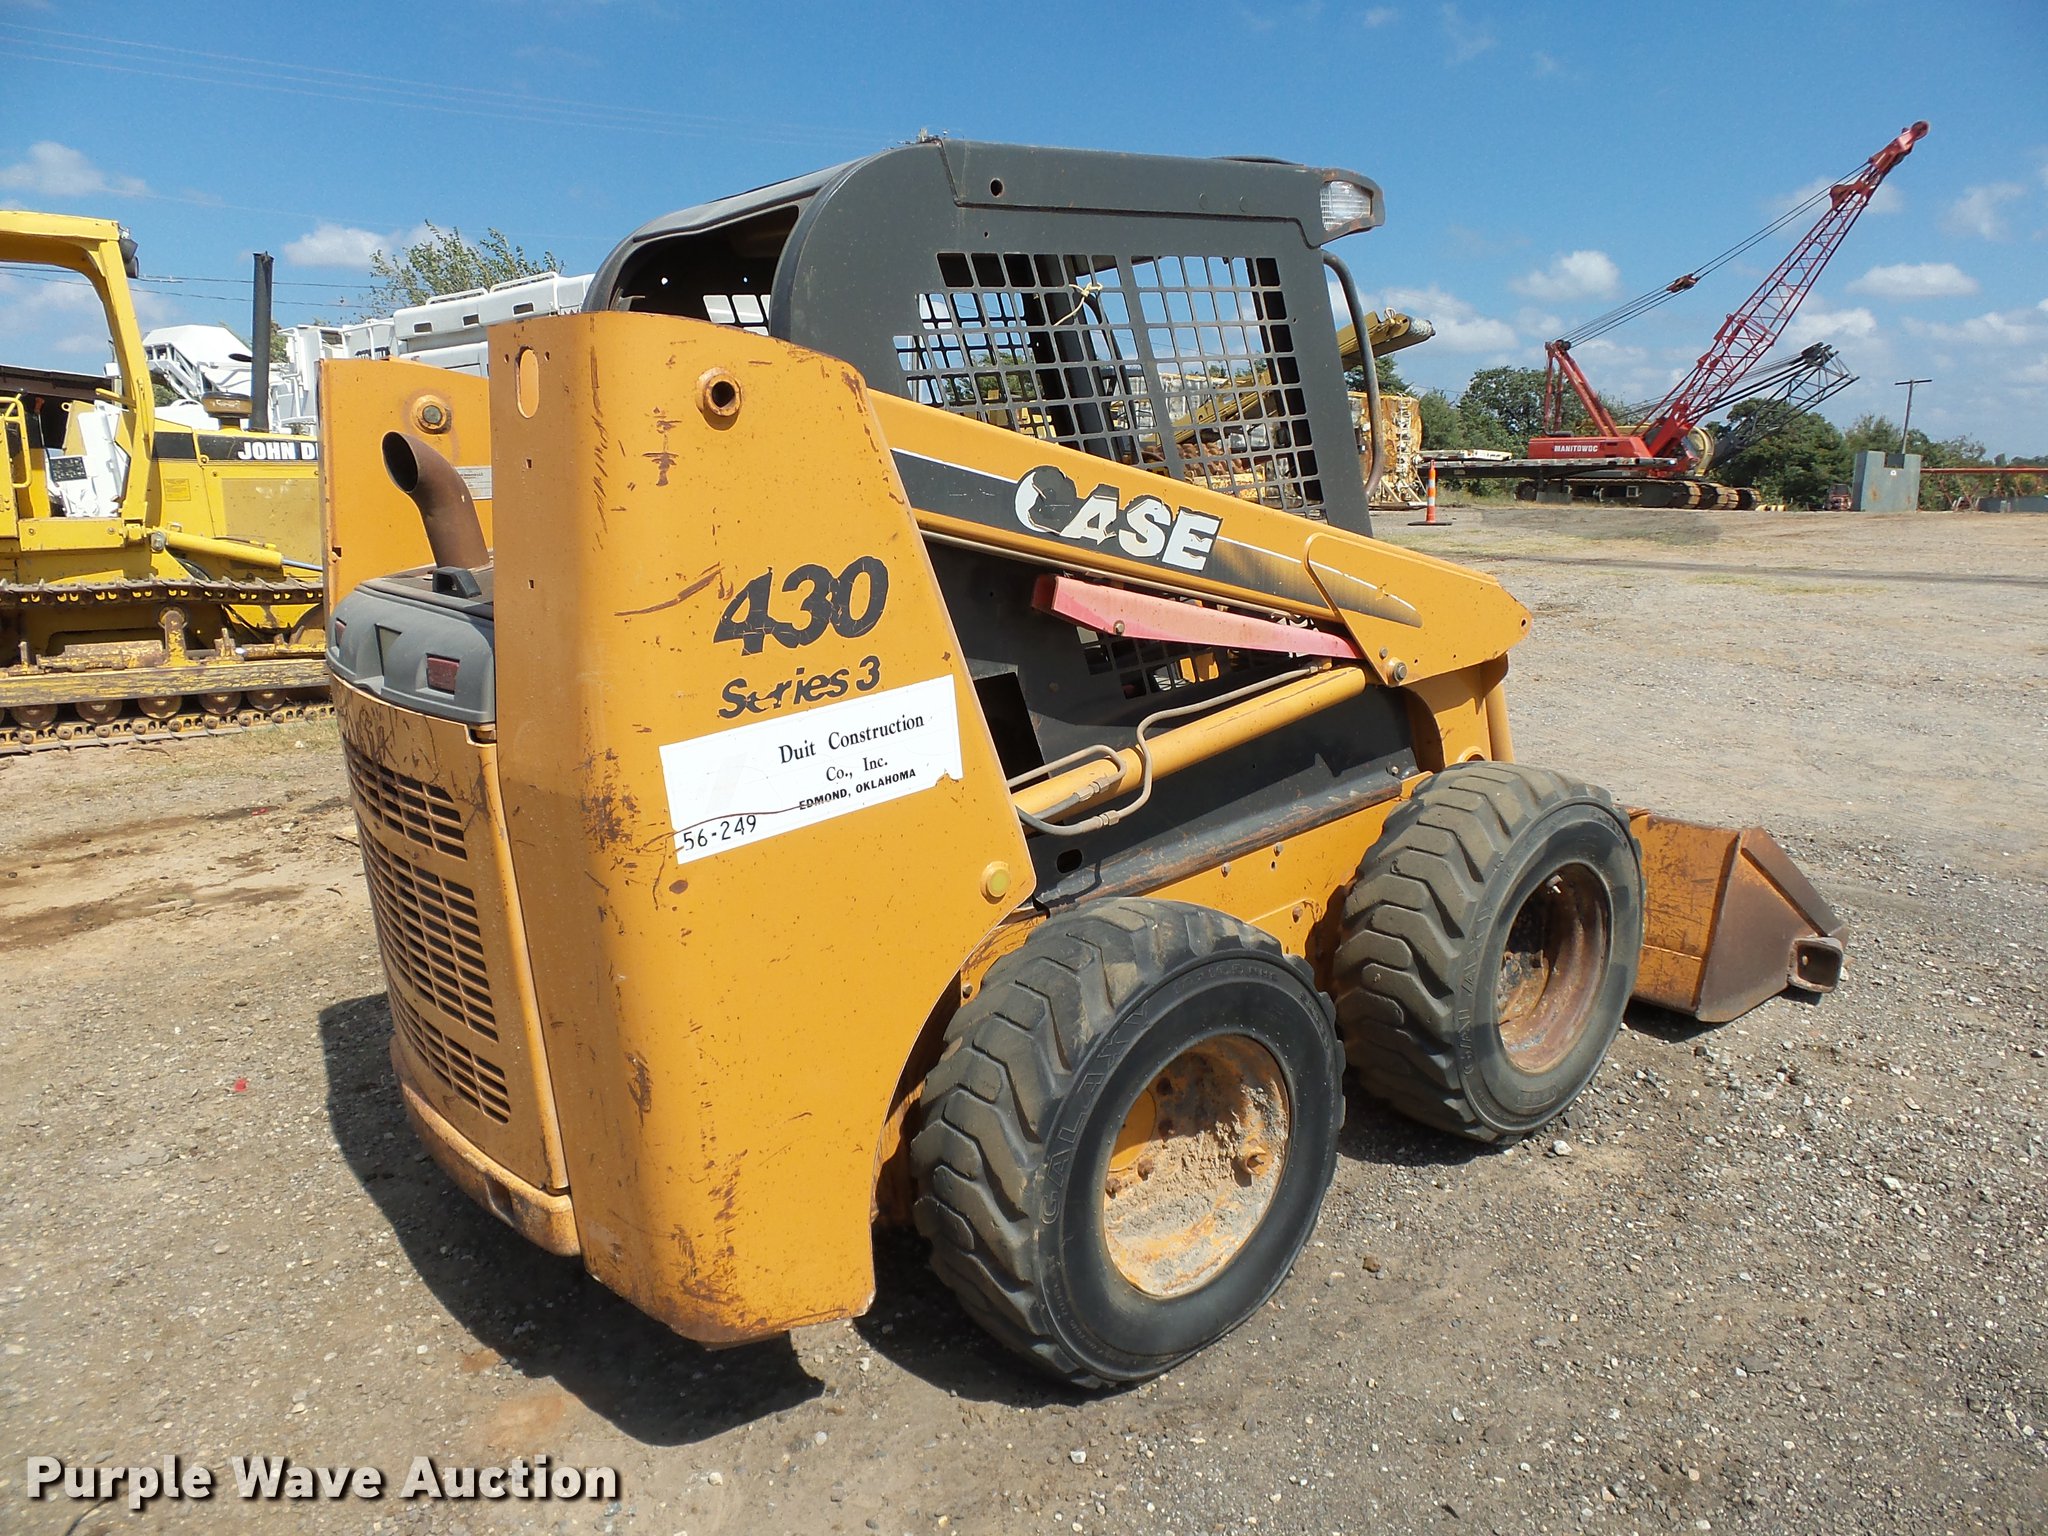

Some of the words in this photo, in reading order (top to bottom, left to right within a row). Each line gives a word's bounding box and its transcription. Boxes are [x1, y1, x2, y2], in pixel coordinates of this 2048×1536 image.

[238, 441, 296, 460] JOHN
[300, 441, 318, 460] D
[1014, 466, 1221, 571] CASE
[713, 555, 889, 657] 430
[717, 667, 851, 719] Series
[855, 655, 881, 692] 3
[778, 739, 816, 764] Duit
[827, 713, 925, 751] Construction
[799, 788, 851, 811] EDMOND,
[855, 768, 917, 794] OKLAHOMA
[825, 765, 854, 784] Co.,
[863, 755, 889, 772] Inc.
[683, 814, 758, 851] 56-249
